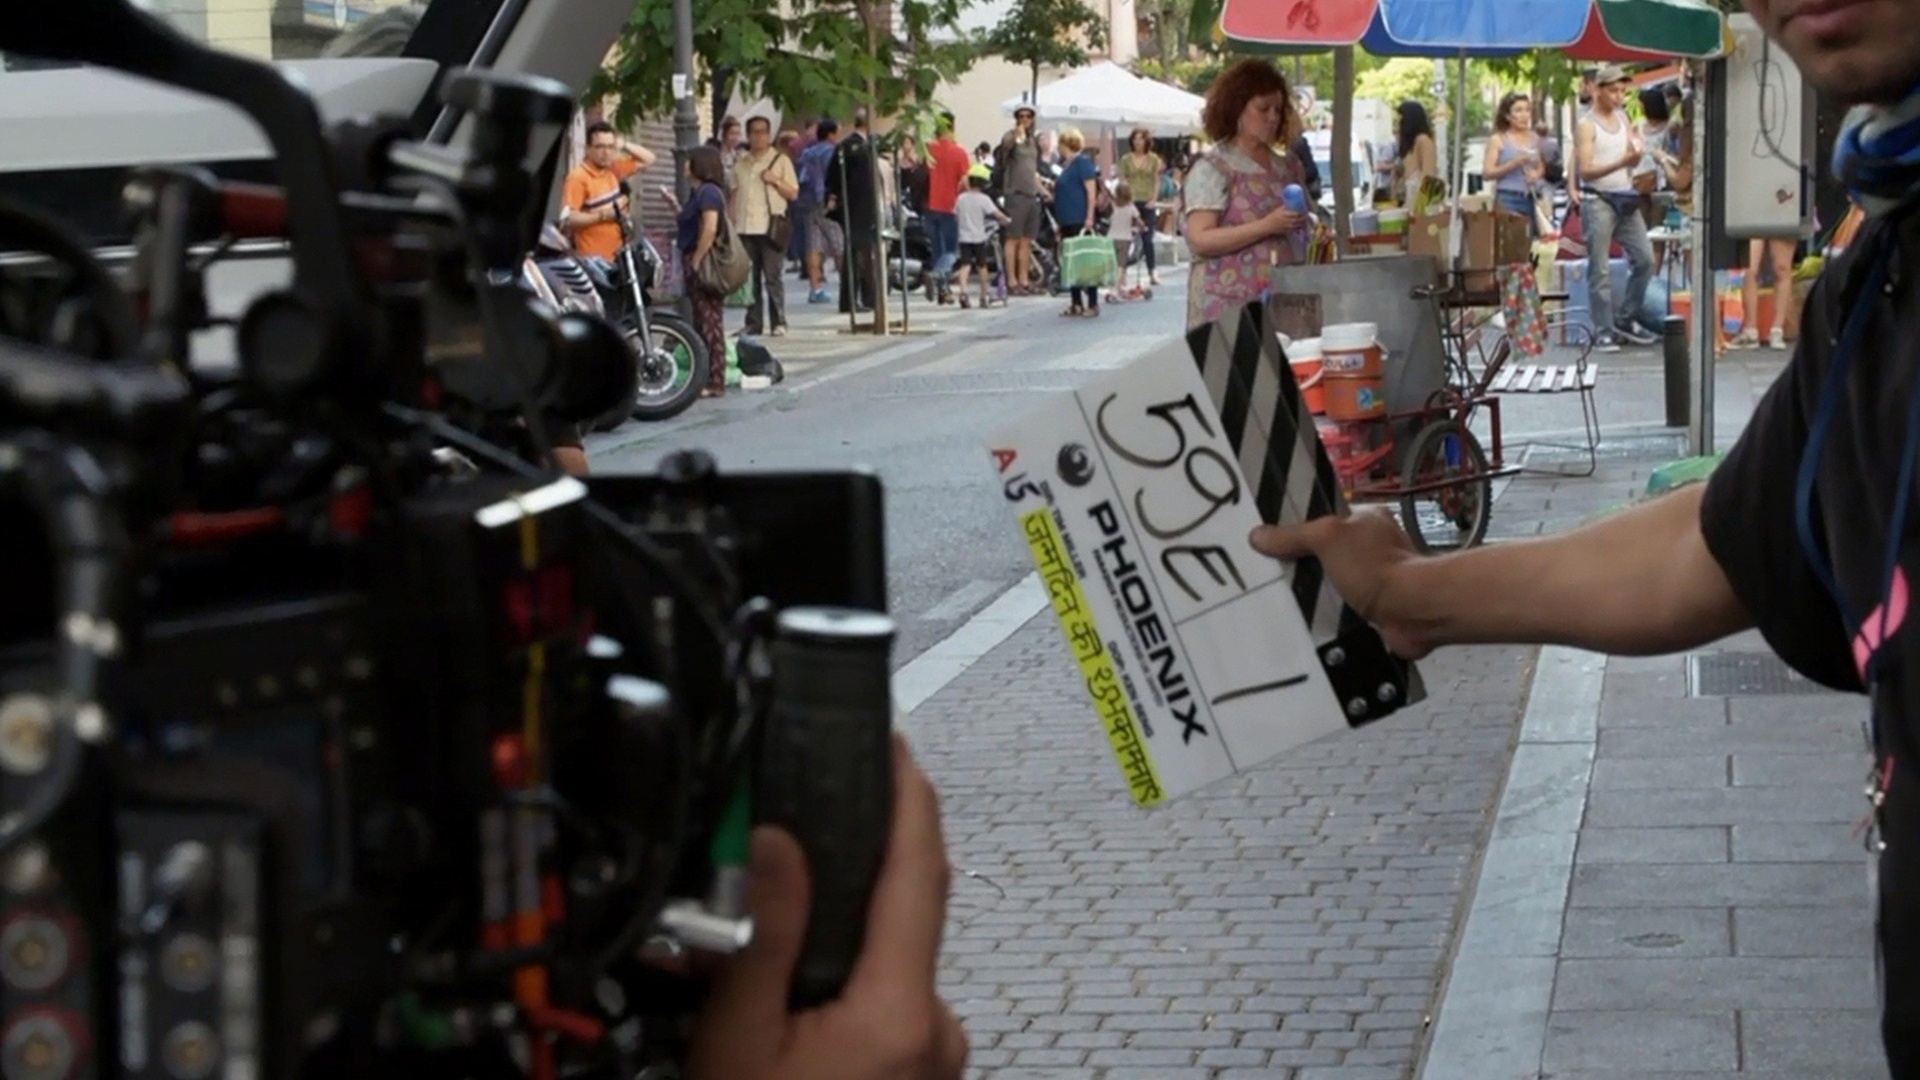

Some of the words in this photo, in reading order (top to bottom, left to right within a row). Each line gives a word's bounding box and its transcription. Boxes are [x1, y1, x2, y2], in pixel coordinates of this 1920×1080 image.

[991, 449, 1018, 473] A
[1062, 533, 1085, 579] MILLER
[1072, 621, 1103, 662] की
[1087, 498, 1208, 745] PHOENIX
